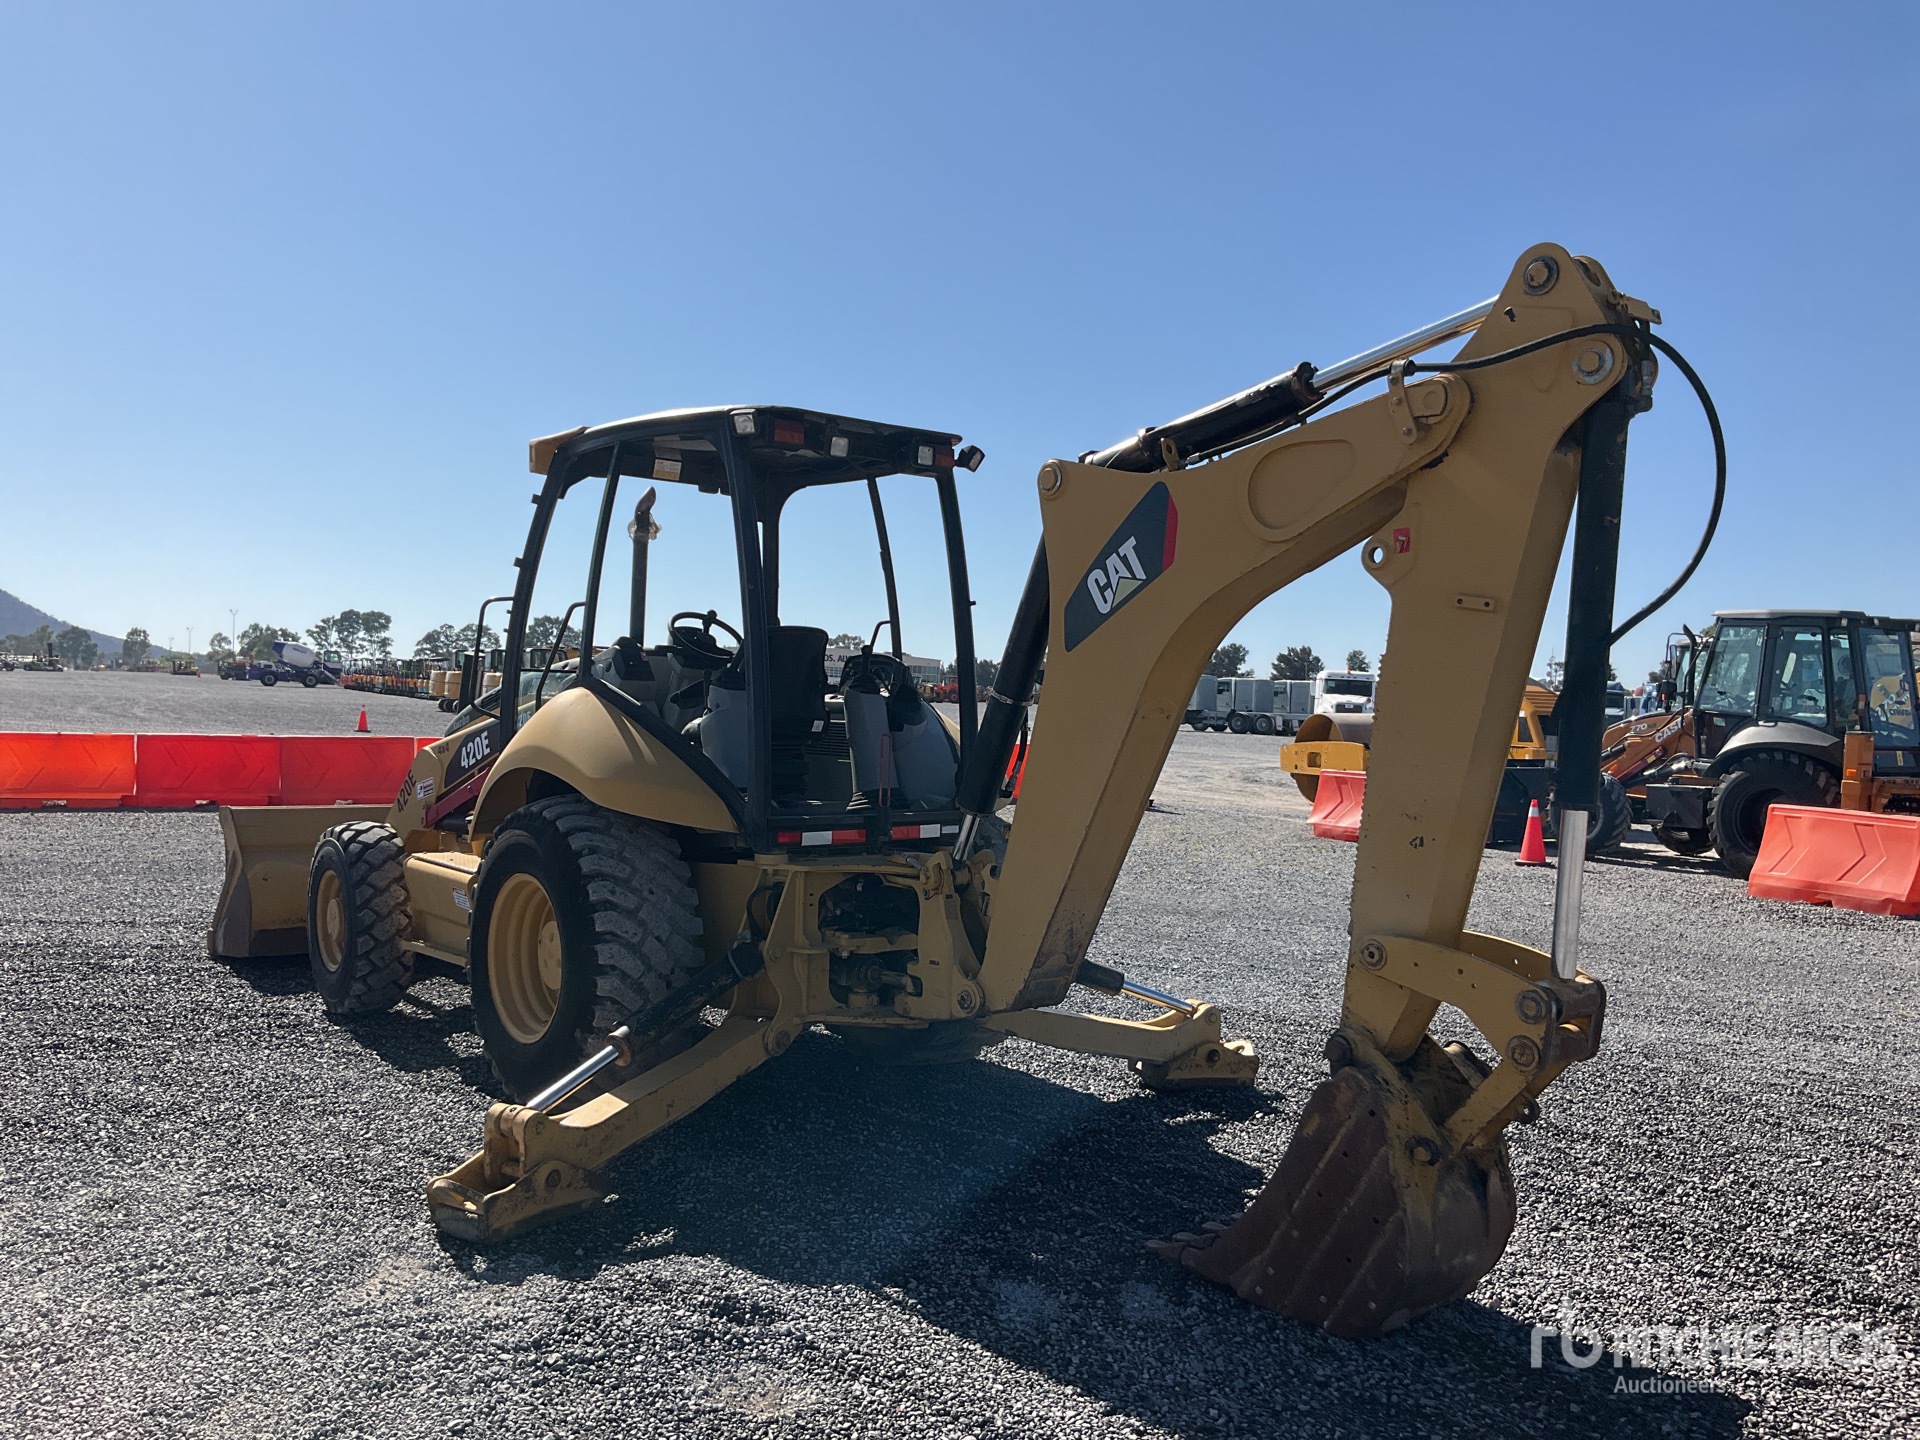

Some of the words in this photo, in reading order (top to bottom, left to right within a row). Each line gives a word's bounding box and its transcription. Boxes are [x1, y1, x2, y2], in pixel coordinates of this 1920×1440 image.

[1086, 535, 1147, 614] CAT
[460, 730, 491, 769] 420E
[396, 768, 417, 813] 420E
